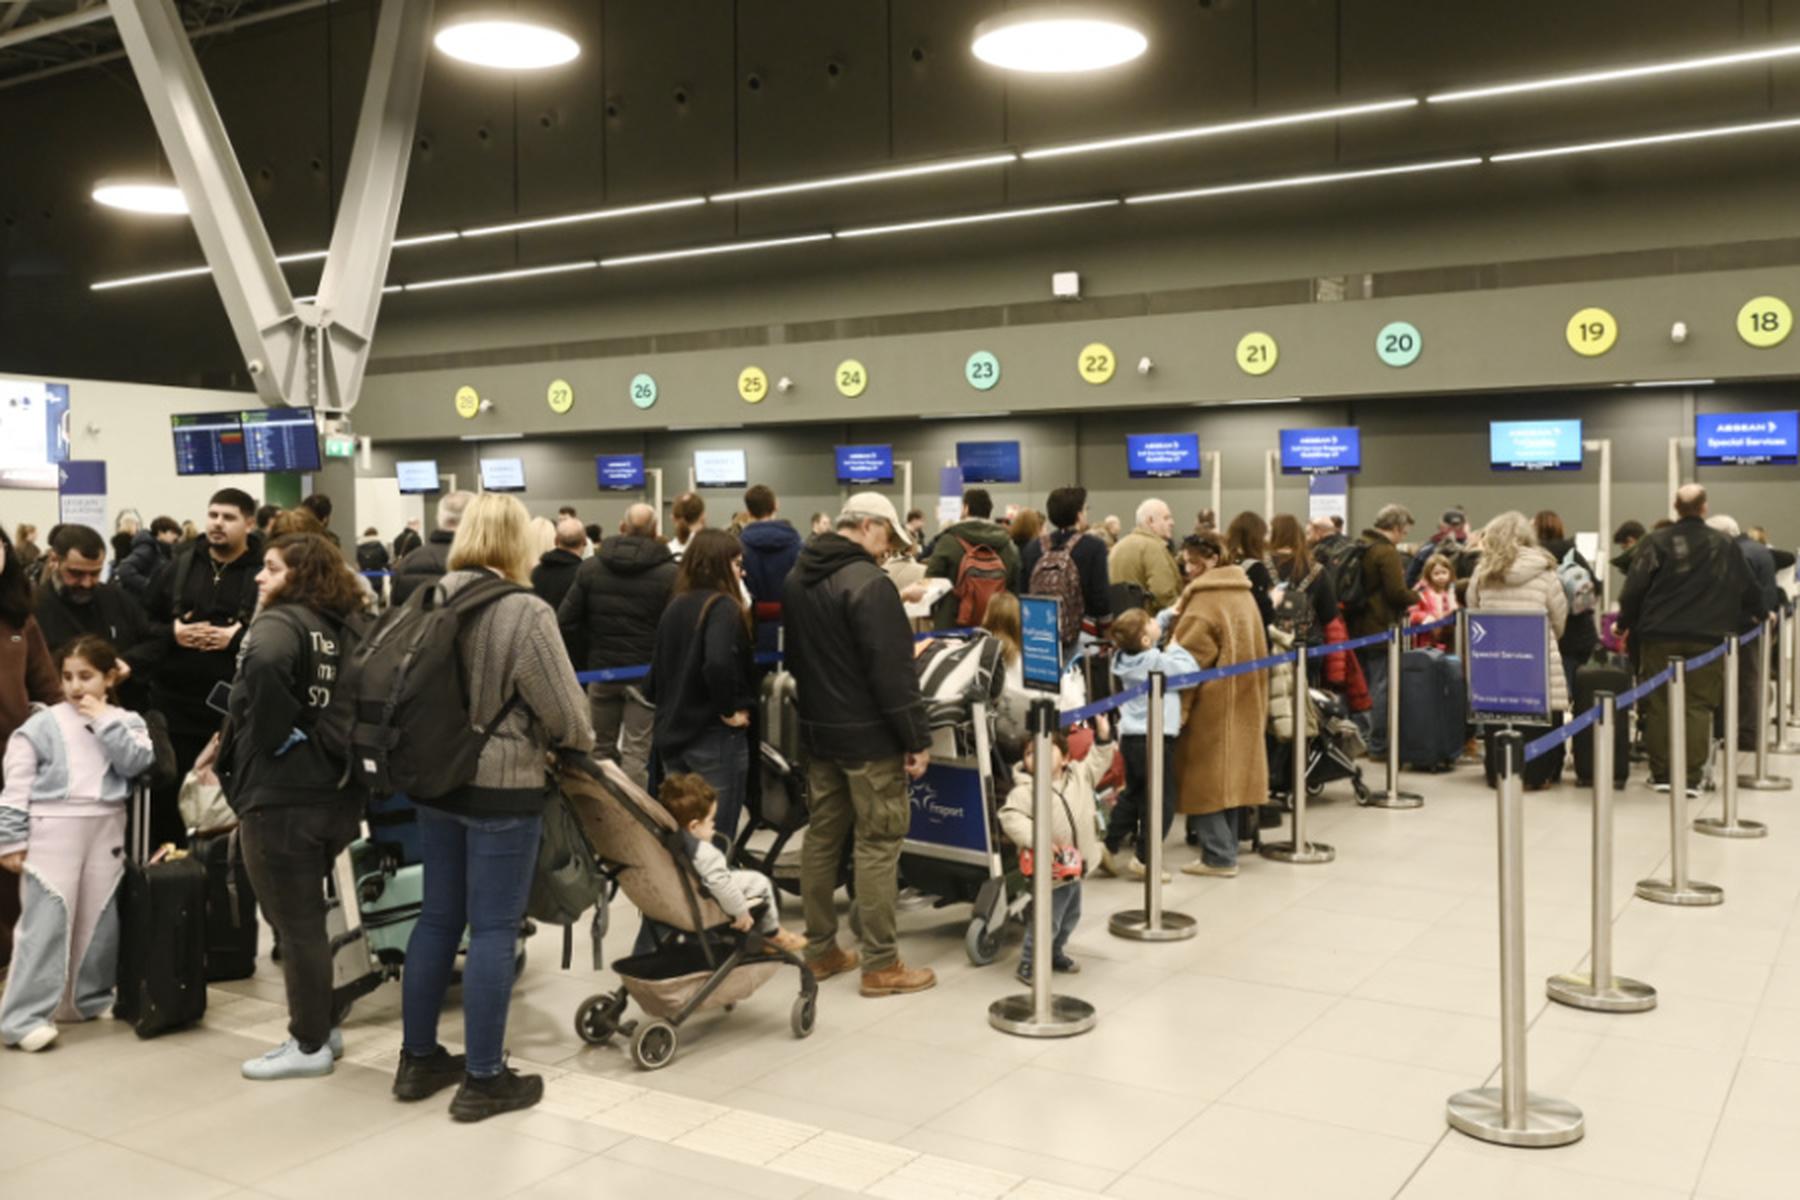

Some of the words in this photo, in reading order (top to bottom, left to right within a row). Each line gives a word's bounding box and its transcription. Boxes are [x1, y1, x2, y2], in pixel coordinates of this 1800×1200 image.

[1751, 311, 1780, 332] 18
[1579, 322, 1605, 342] 19
[1384, 333, 1414, 353] 20
[1246, 344, 1268, 363] 21
[972, 361, 994, 379] 23
[1085, 355, 1108, 373] 22
[743, 376, 762, 393] 25
[841, 370, 861, 387] 24
[552, 389, 568, 405] 27
[634, 382, 653, 399] 26
